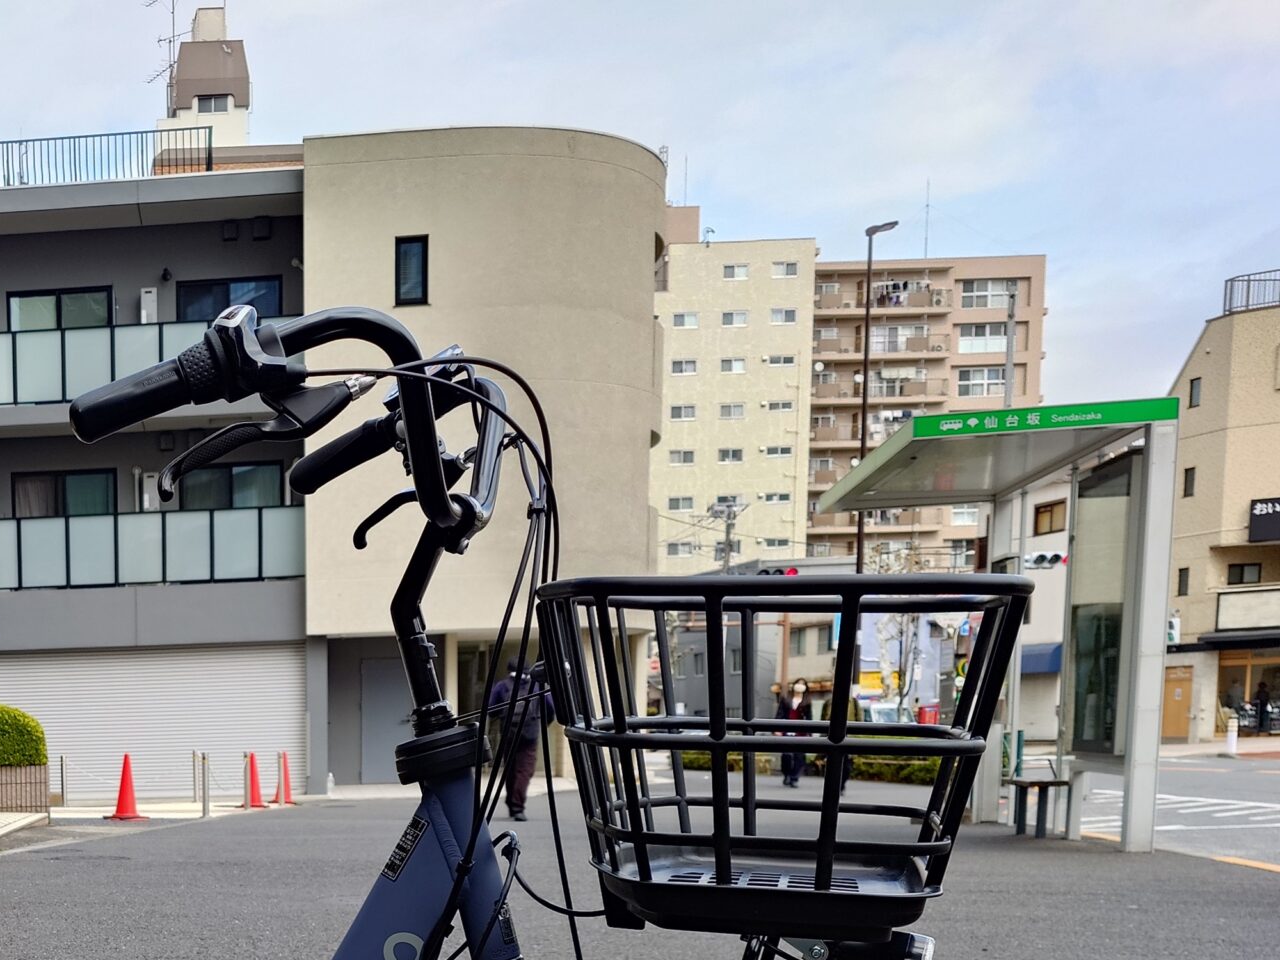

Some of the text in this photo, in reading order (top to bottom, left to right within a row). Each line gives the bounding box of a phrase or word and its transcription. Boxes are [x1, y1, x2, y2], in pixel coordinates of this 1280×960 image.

[984, 412, 1102, 429] 仙台坂 Sendaizaka
